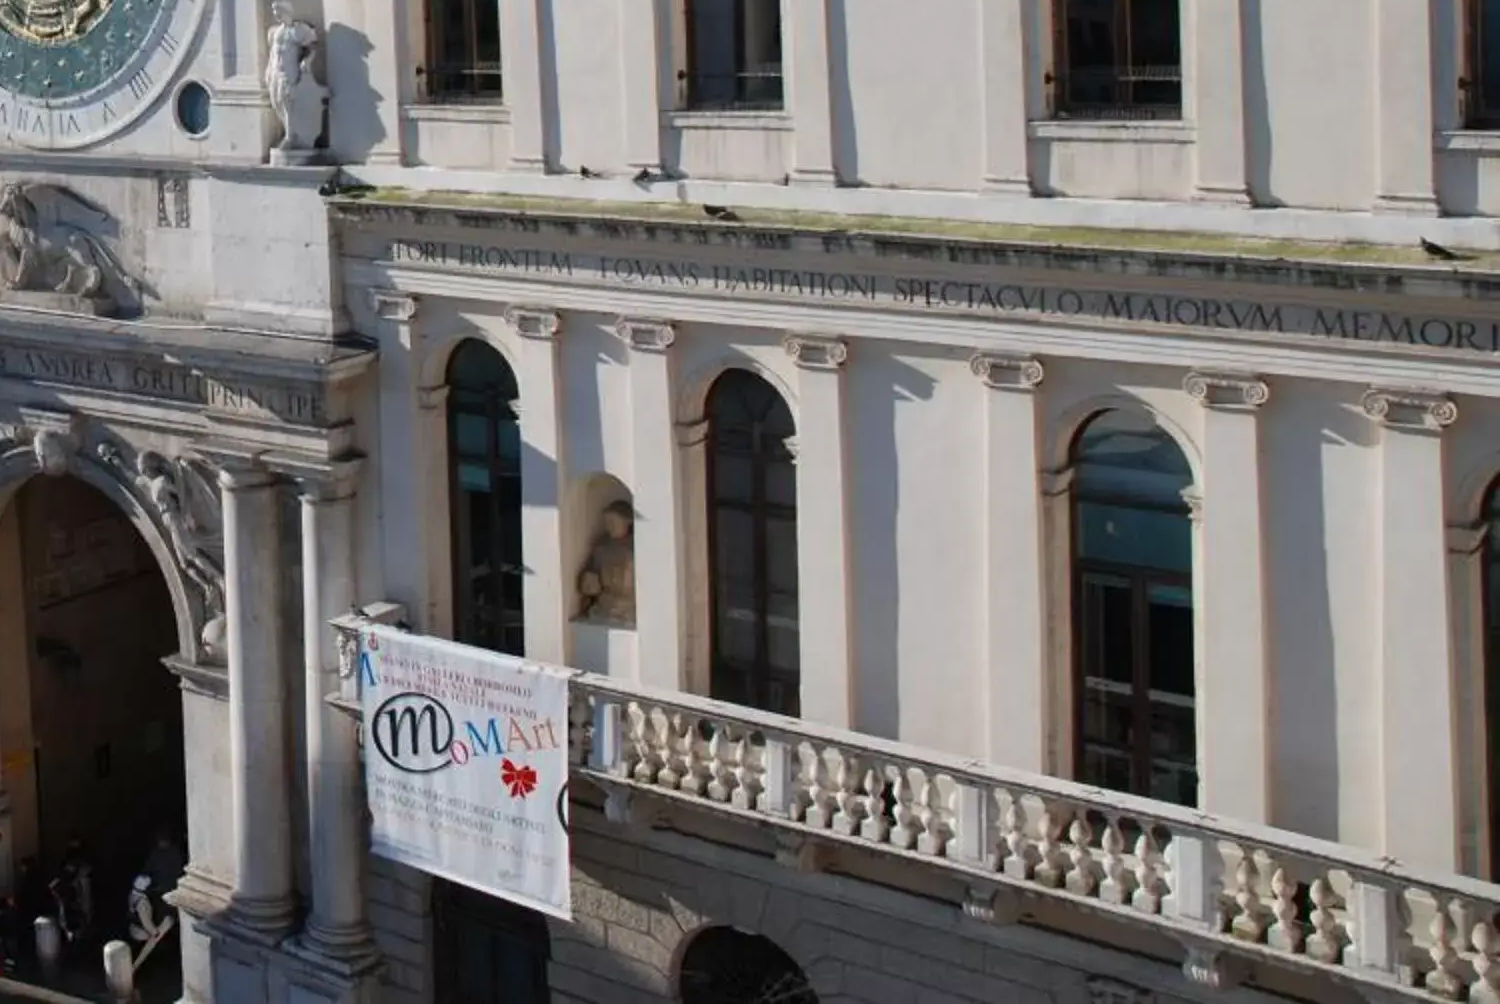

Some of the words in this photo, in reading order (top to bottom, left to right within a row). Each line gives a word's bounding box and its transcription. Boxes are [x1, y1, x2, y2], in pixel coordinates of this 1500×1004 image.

[160, 32, 180, 58] III
[128, 67, 153, 101] IIII
[16, 106, 46, 136] VII
[58, 113, 81, 136] VI
[102, 99, 117, 124] V
[893, 277, 1084, 315] SPECTACVLO
[1102, 292, 1283, 333] MAIORVM
